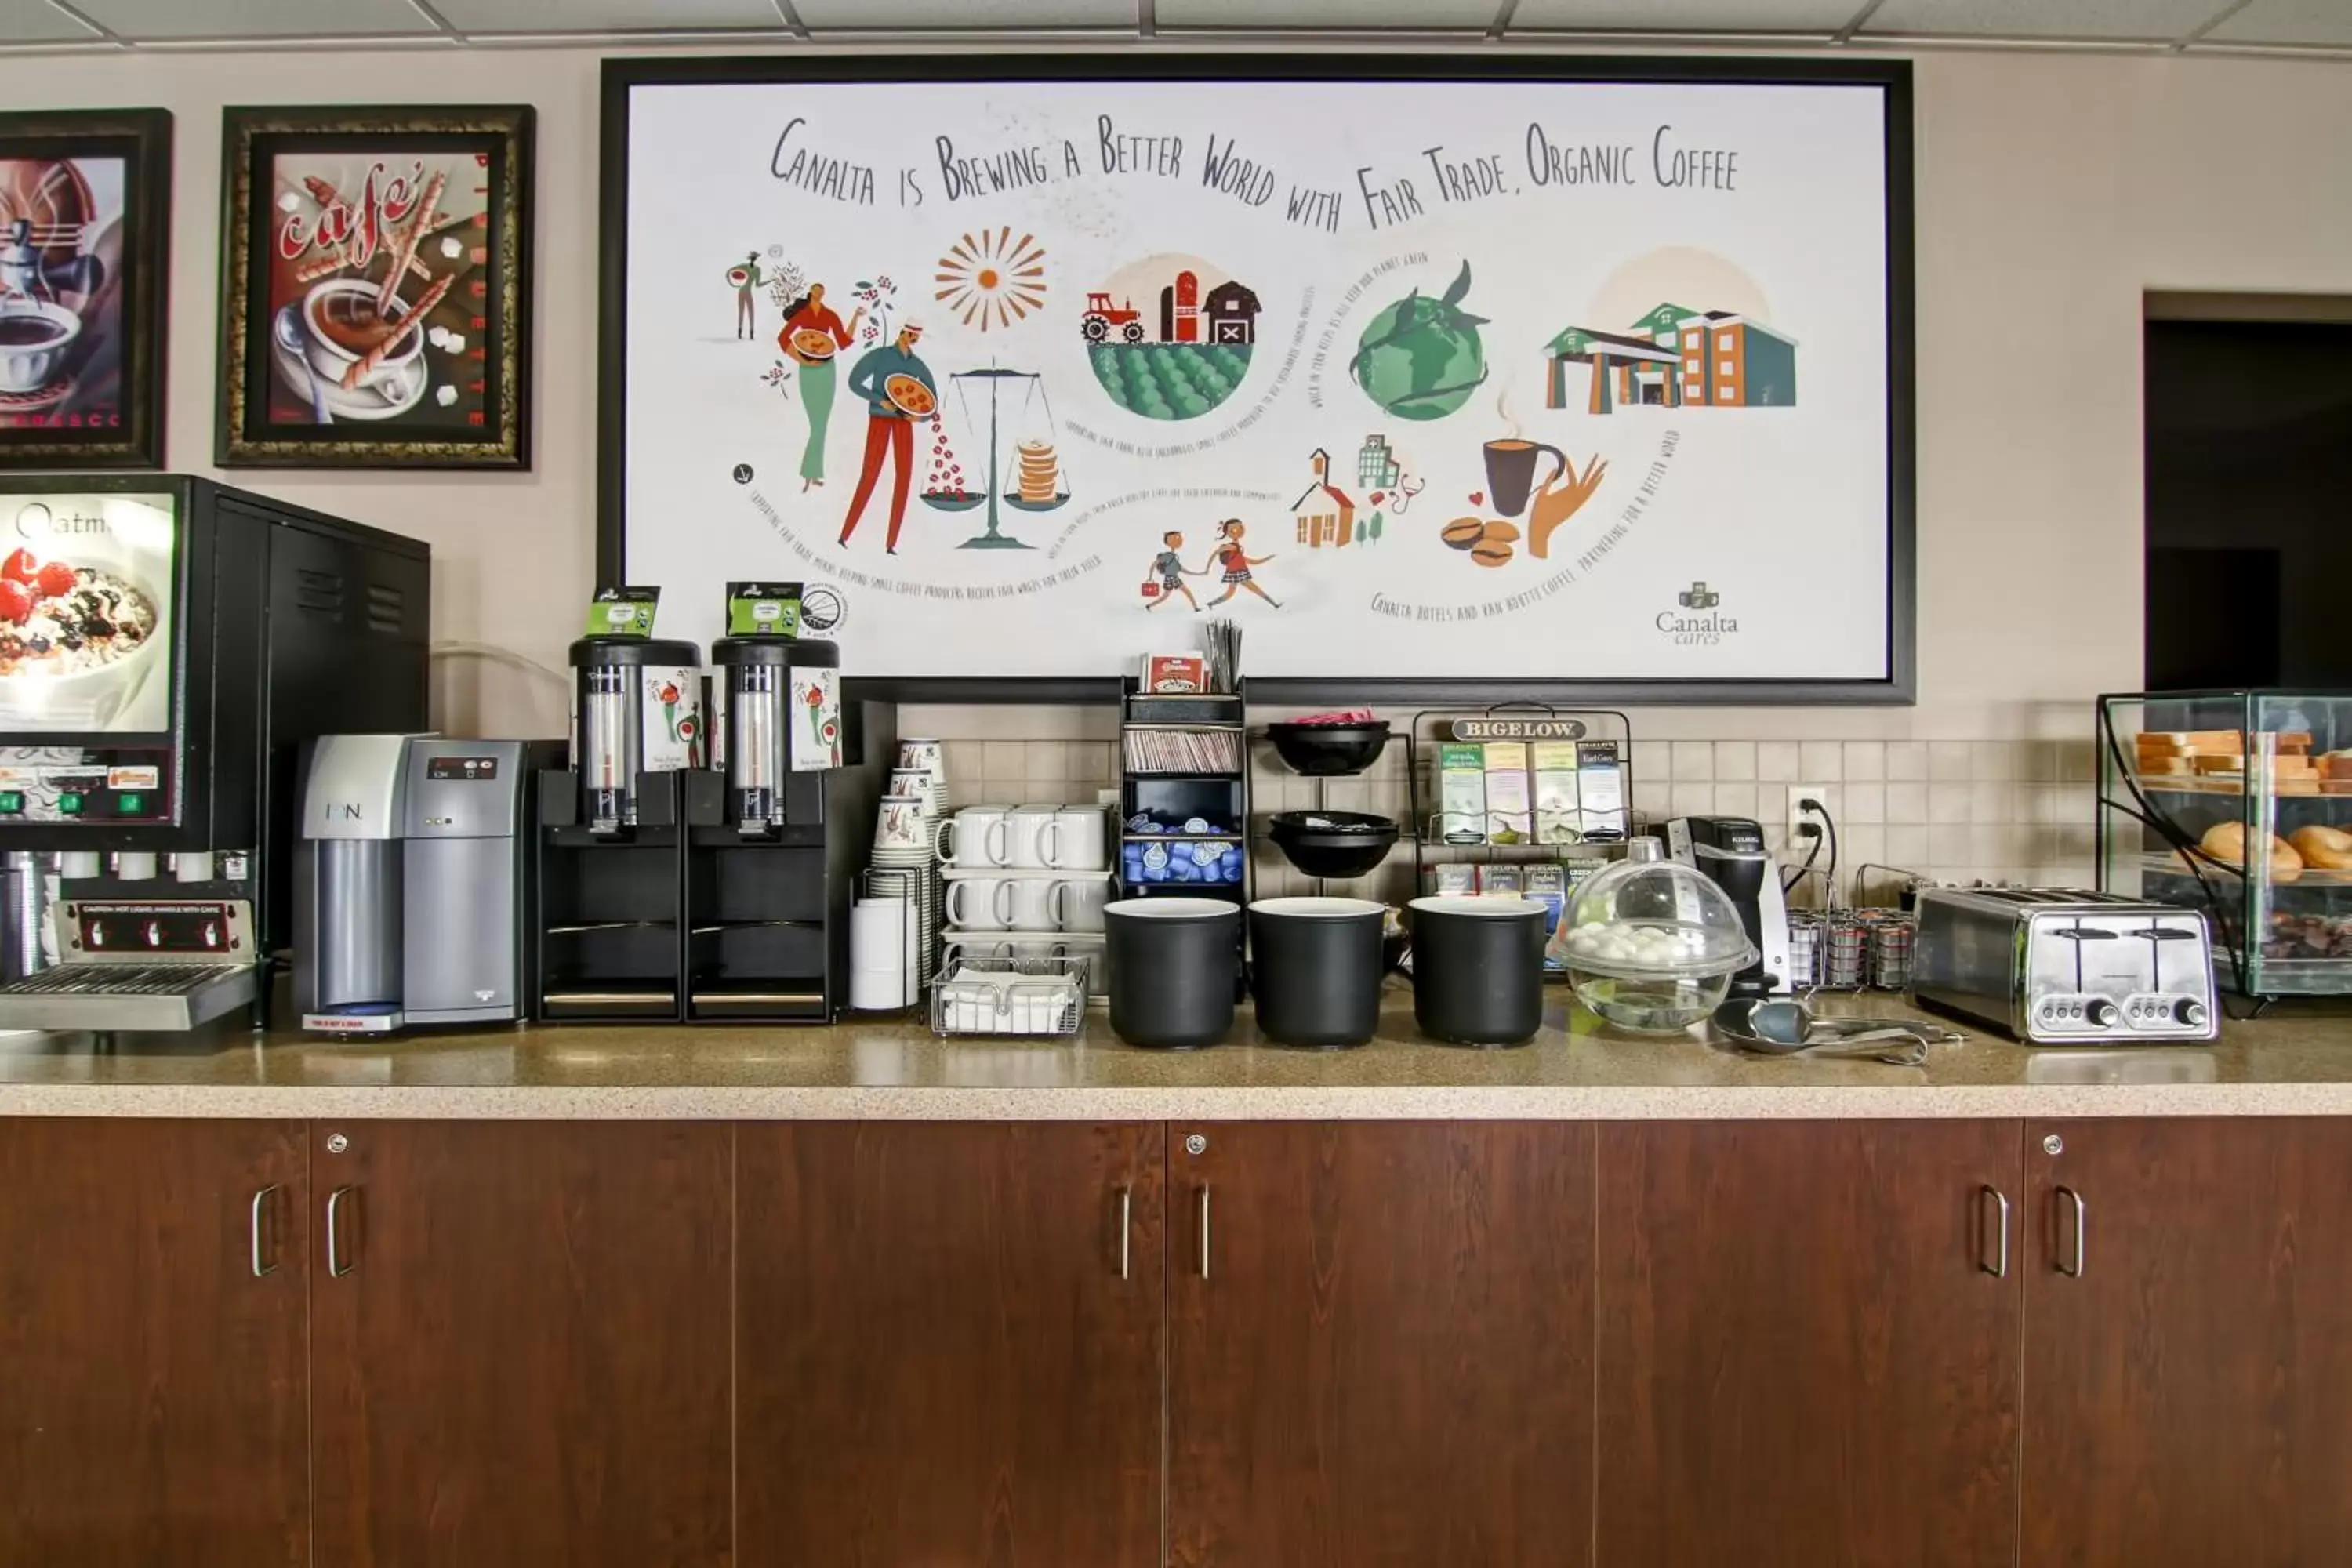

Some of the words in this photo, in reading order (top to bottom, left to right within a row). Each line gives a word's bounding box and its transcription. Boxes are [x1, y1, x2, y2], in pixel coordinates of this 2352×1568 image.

[771, 117, 874, 205] CANALTA
[900, 169, 923, 207] IS
[935, 135, 1047, 201] BREWING
[1064, 140, 1081, 178] A
[1098, 114, 1183, 179] BETTER
[1202, 133, 1275, 207] WORLD
[1287, 185, 1341, 234] WITH
[1356, 166, 1424, 230] FAIR
[1526, 122, 1635, 187] ORGANIC
[1653, 125, 1737, 191] COFFEE
[279, 158, 424, 269] café
[1370, 590, 1412, 619] CANALTA
[1416, 604, 1453, 622] HOTELS
[1457, 604, 1478, 620] AND
[1482, 601, 1503, 616] VAN
[1541, 568, 1576, 595] COFFEE
[1577, 524, 1627, 570] PARTNERING
[1621, 504, 1642, 524] FOR
[895, 581, 922, 596] COFFEE
[1655, 610, 1739, 633] Canalta
[1674, 631, 1721, 646] cares
[1465, 721, 1575, 737] BIGELOW
